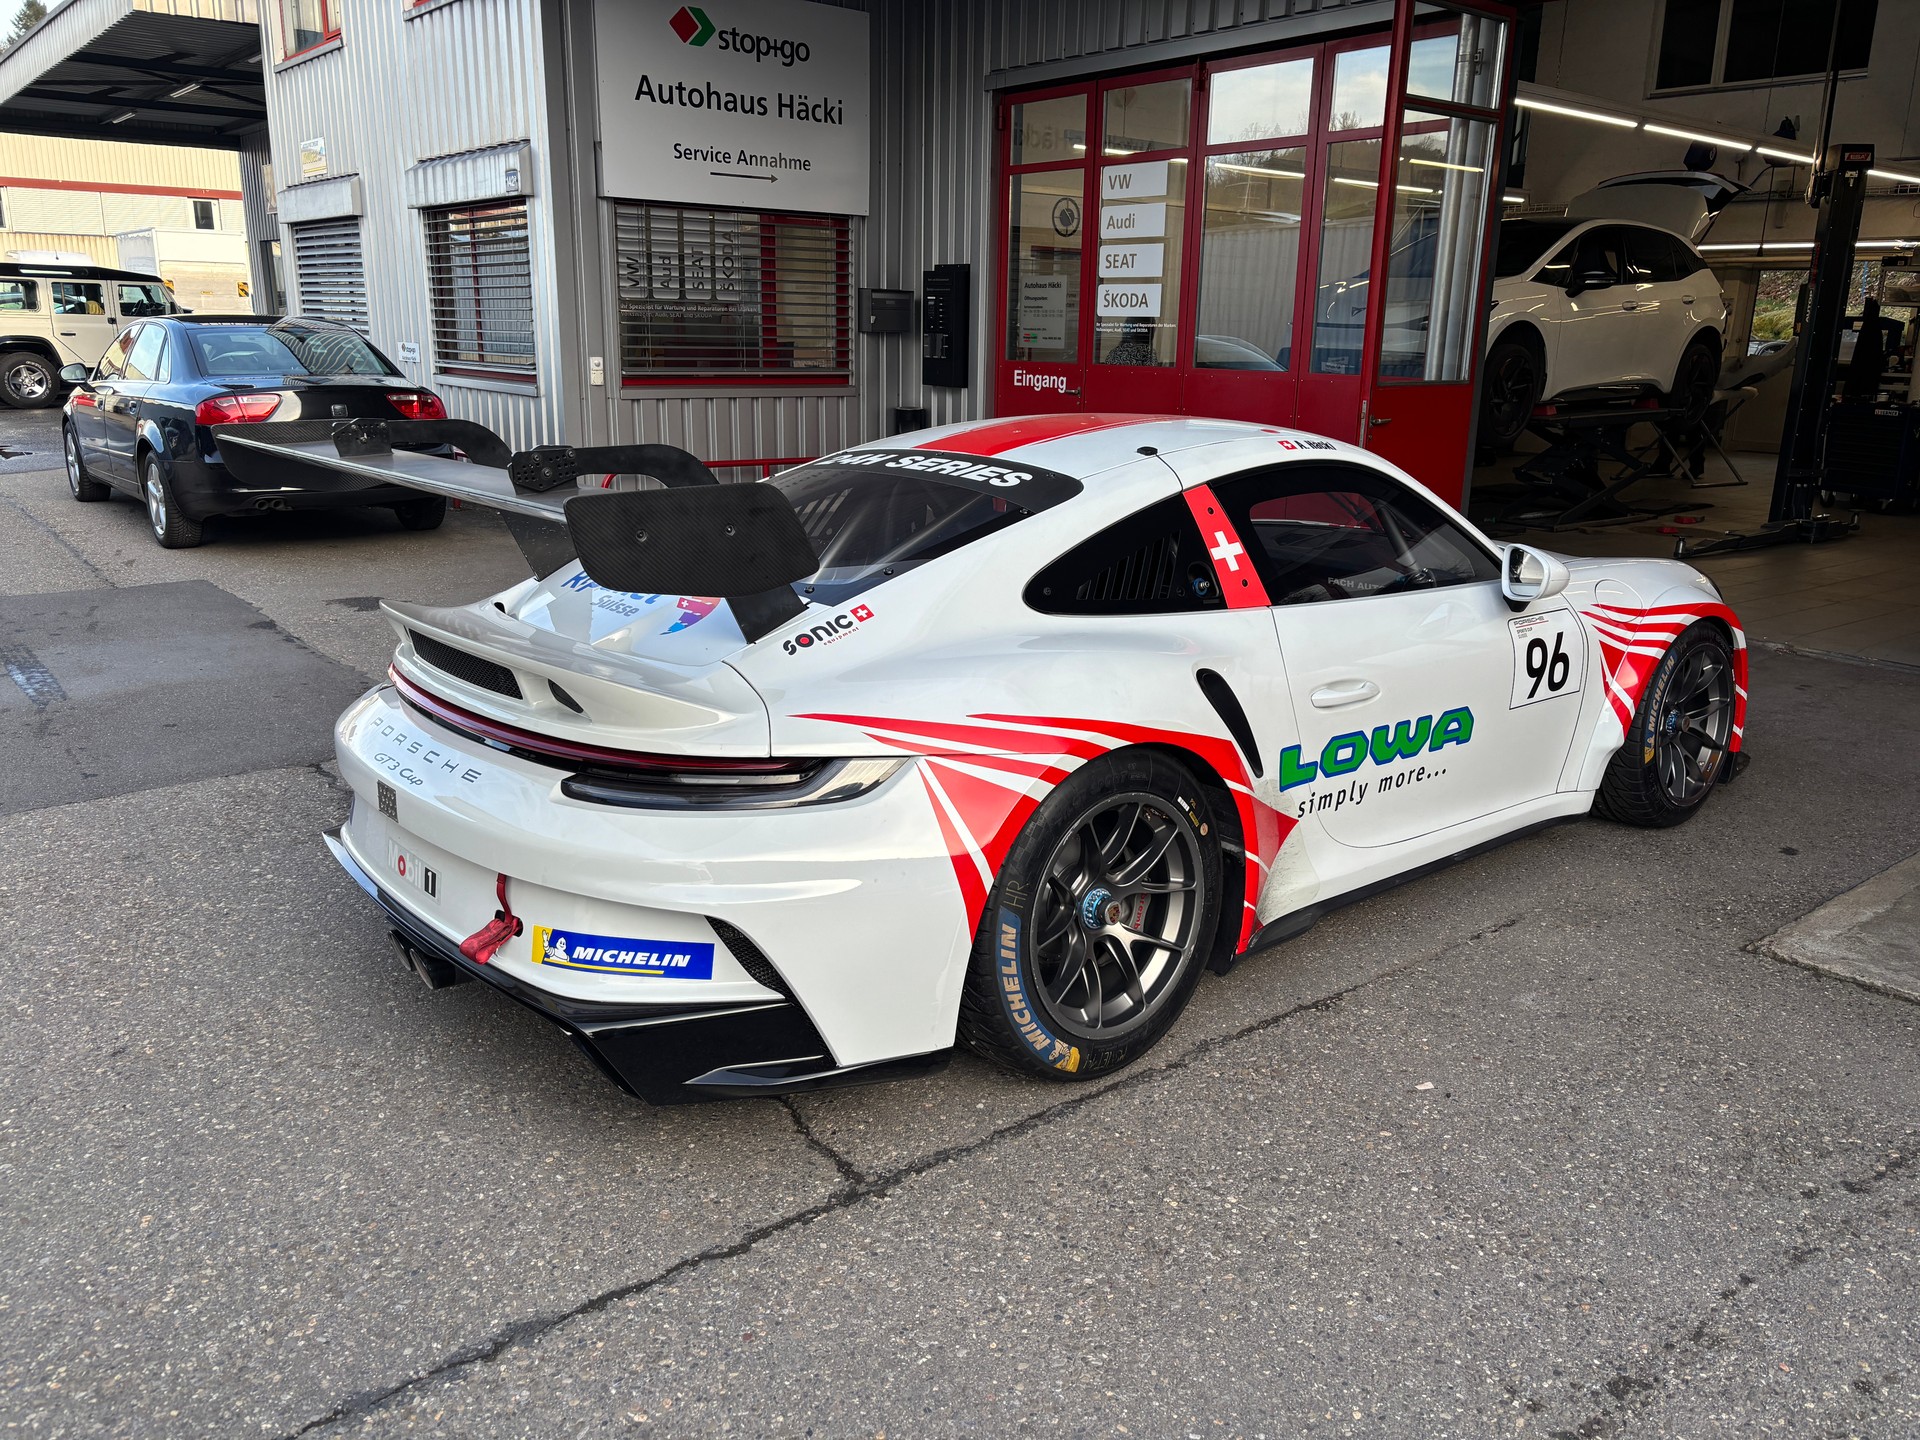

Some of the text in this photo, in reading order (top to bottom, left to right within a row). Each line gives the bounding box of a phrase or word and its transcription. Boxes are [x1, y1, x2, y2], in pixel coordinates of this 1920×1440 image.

[718, 26, 811, 67] stop+go
[634, 74, 844, 125] Autohaus Häcki
[673, 142, 811, 171] Service Annahme
[1108, 173, 1132, 190] VW
[1106, 213, 1136, 230] Audi
[626, 257, 640, 288] VW
[659, 254, 671, 289] Aud
[1105, 253, 1138, 269] SEAT
[1103, 289, 1149, 308] ŠKODA
[1013, 370, 1067, 393] Eingang
[885, 455, 1033, 487] SERIES
[1327, 577, 1355, 588] FACH
[591, 594, 640, 617] Suisse
[823, 626, 860, 646] equipment
[1526, 631, 1570, 700] 96
[1648, 655, 1675, 733] MICHELIN
[370, 716, 482, 784] PORSCHE
[1279, 706, 1475, 793] LOWA
[374, 752, 424, 786] GT3 Cup
[1298, 766, 1446, 819] simply more...
[388, 839, 422, 889] Mobil
[1133, 893, 1148, 930] bremb
[572, 946, 691, 968] MICHELIN
[1000, 923, 1052, 1051] MICHELIN
